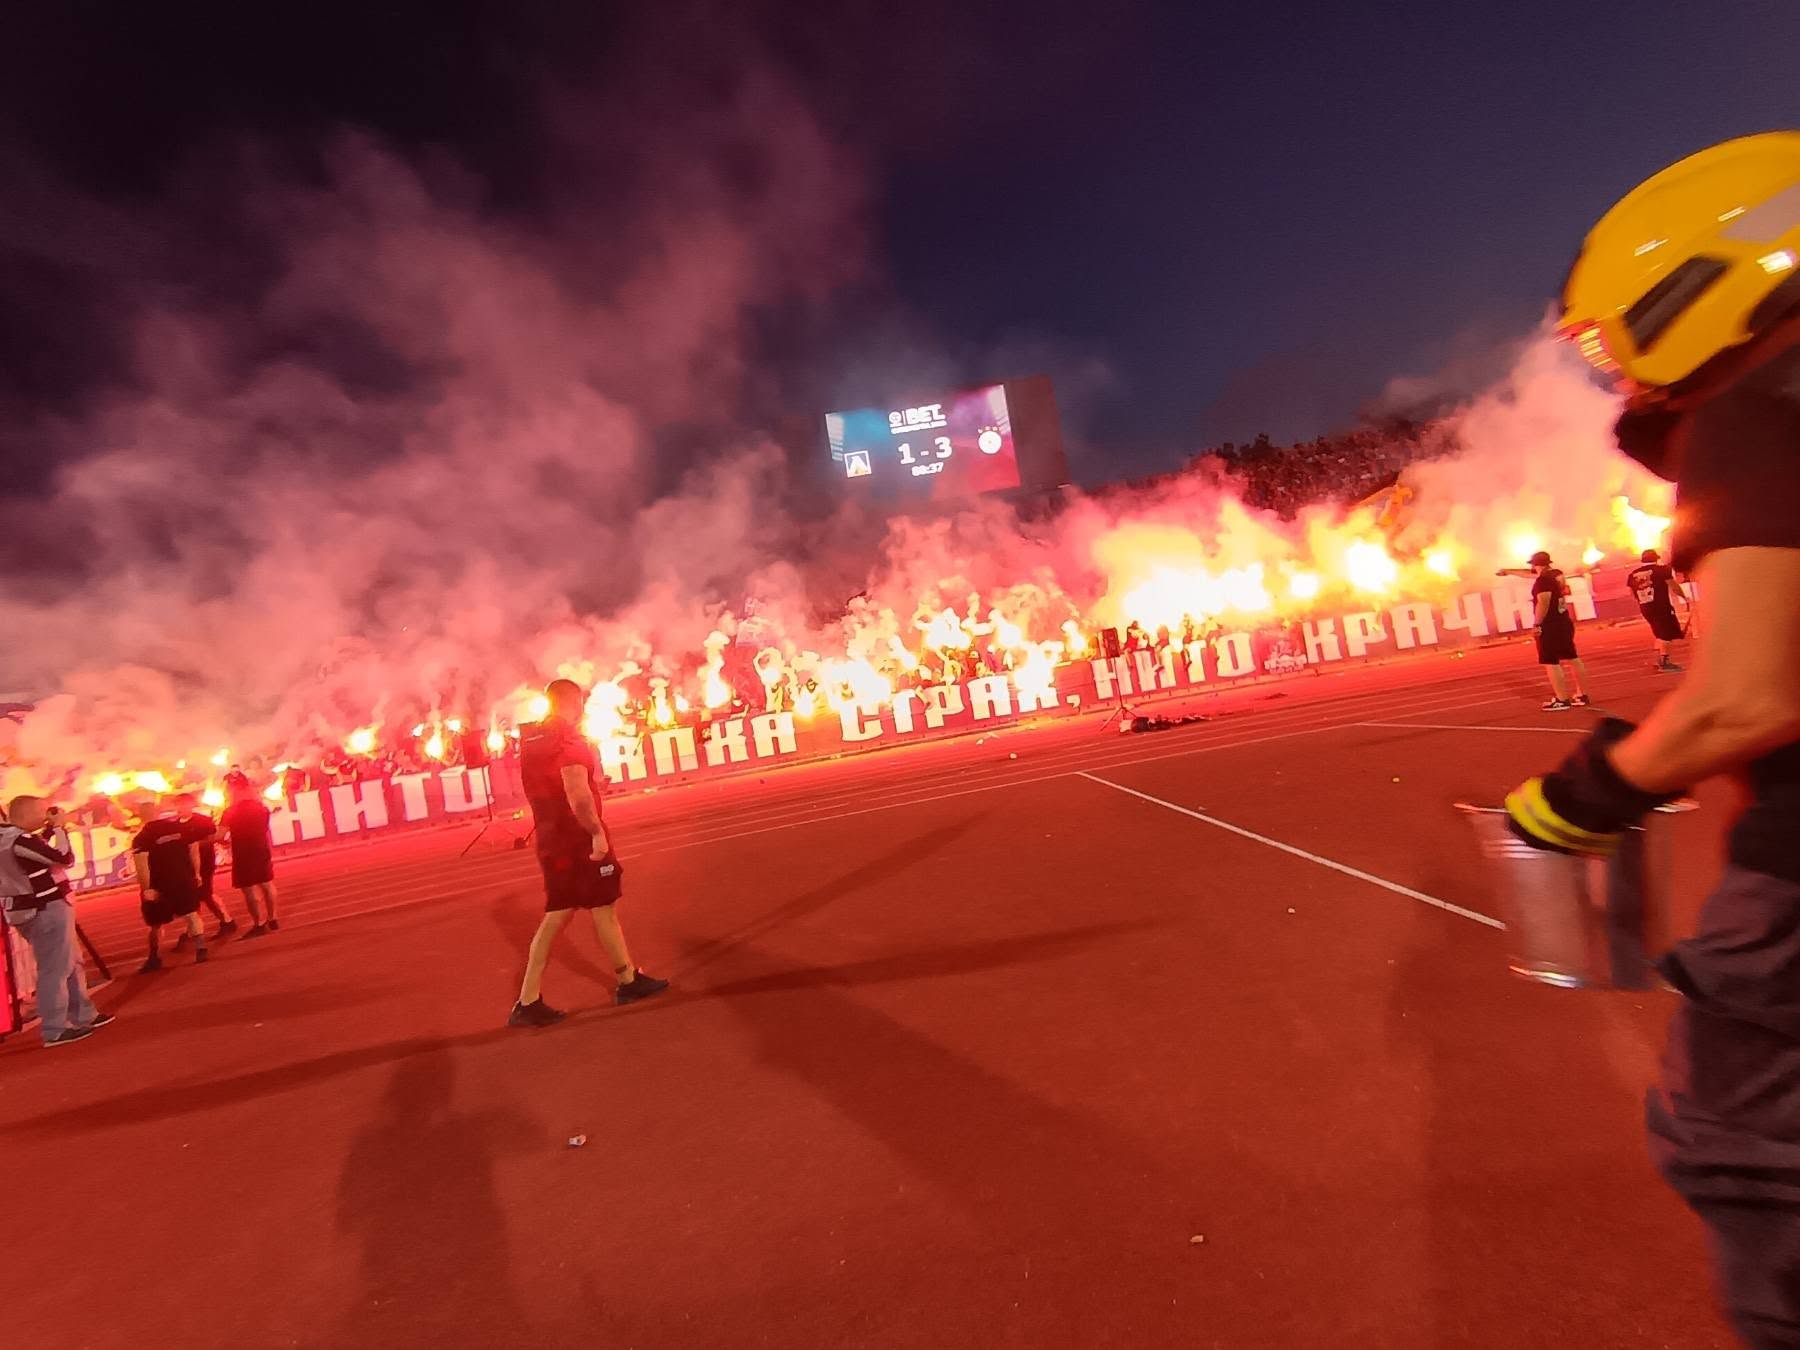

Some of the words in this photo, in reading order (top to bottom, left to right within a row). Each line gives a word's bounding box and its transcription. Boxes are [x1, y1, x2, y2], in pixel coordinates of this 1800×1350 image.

[898, 443, 915, 464] 1
[934, 436, 952, 458] 3
[599, 711, 798, 784] АПКА
